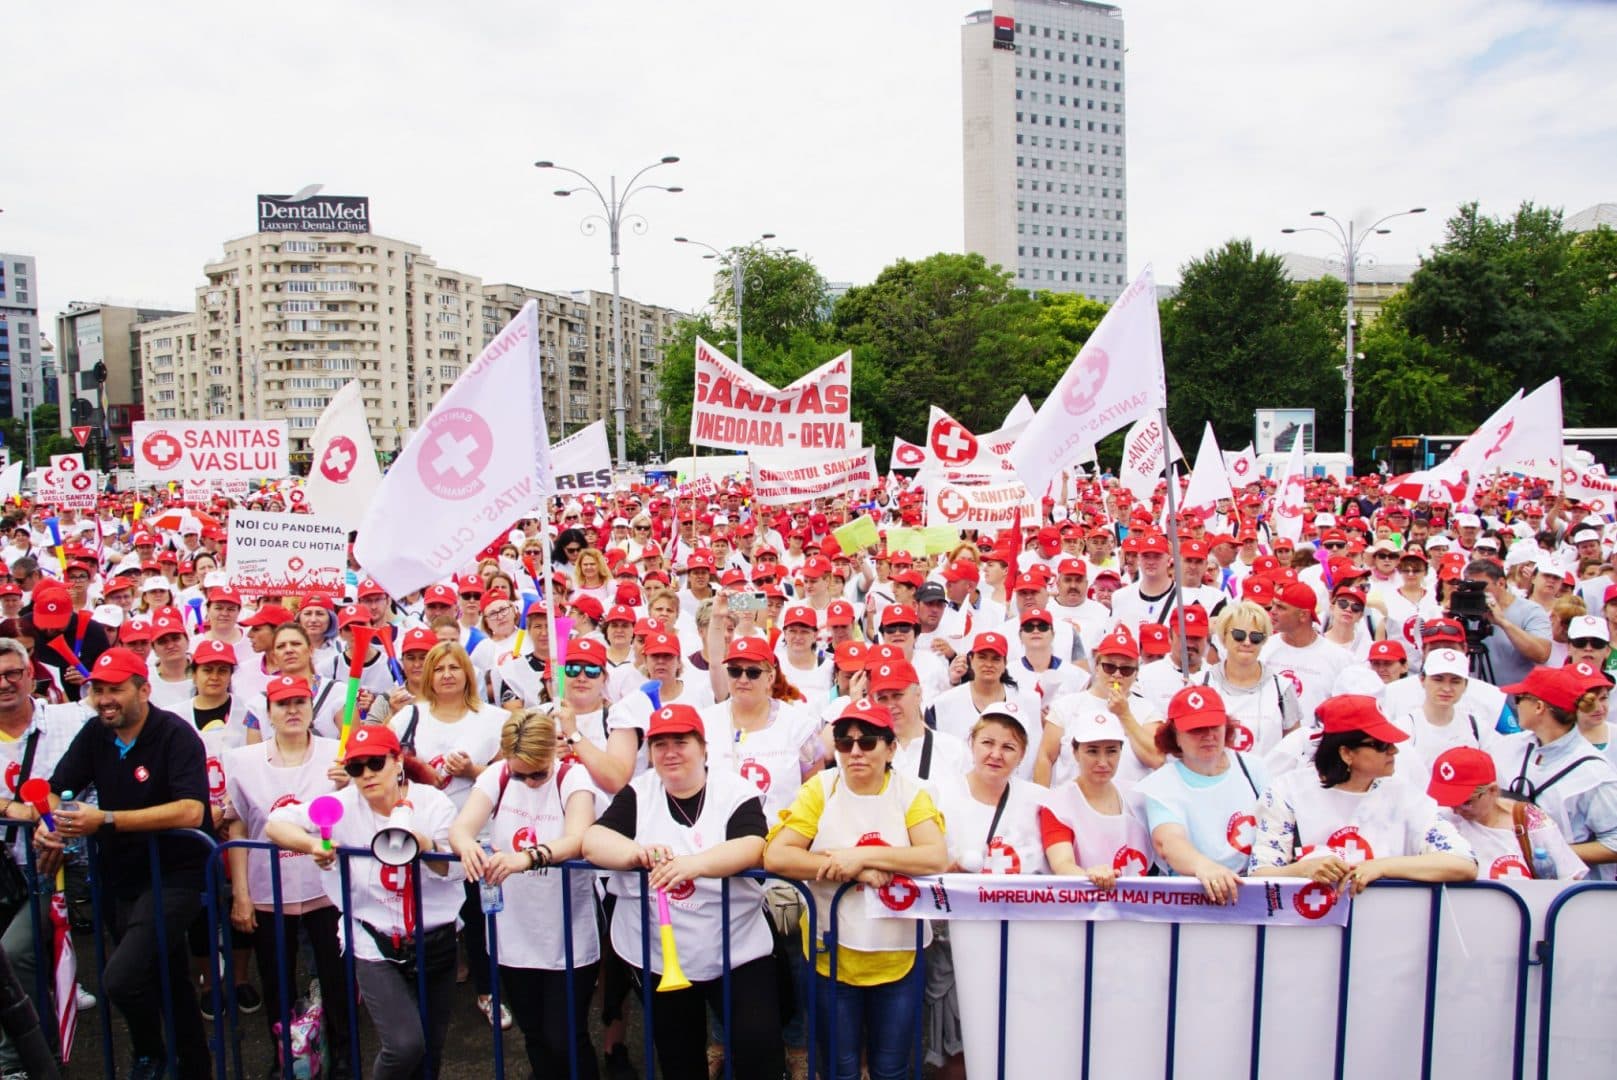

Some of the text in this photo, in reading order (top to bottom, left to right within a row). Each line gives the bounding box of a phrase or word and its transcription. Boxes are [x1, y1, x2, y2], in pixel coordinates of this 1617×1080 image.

[260, 202, 366, 219] DentalMed
[262, 221, 367, 231] Luxury Dental Clinic
[184, 429, 280, 448] SANITAS
[801, 423, 846, 449] DEVA
[190, 452, 277, 471] VASLUI
[823, 455, 867, 476] SANITAS
[972, 487, 1025, 503] SANITAS
[236, 519, 345, 535] NOI CU PANDEMIA,
[236, 537, 256, 547] VOI
[260, 539, 289, 548] DOAR
[292, 541, 306, 549] CU
[978, 886, 1236, 907] ÎMPREUNĂ SUNTEM MAI PUTERN
